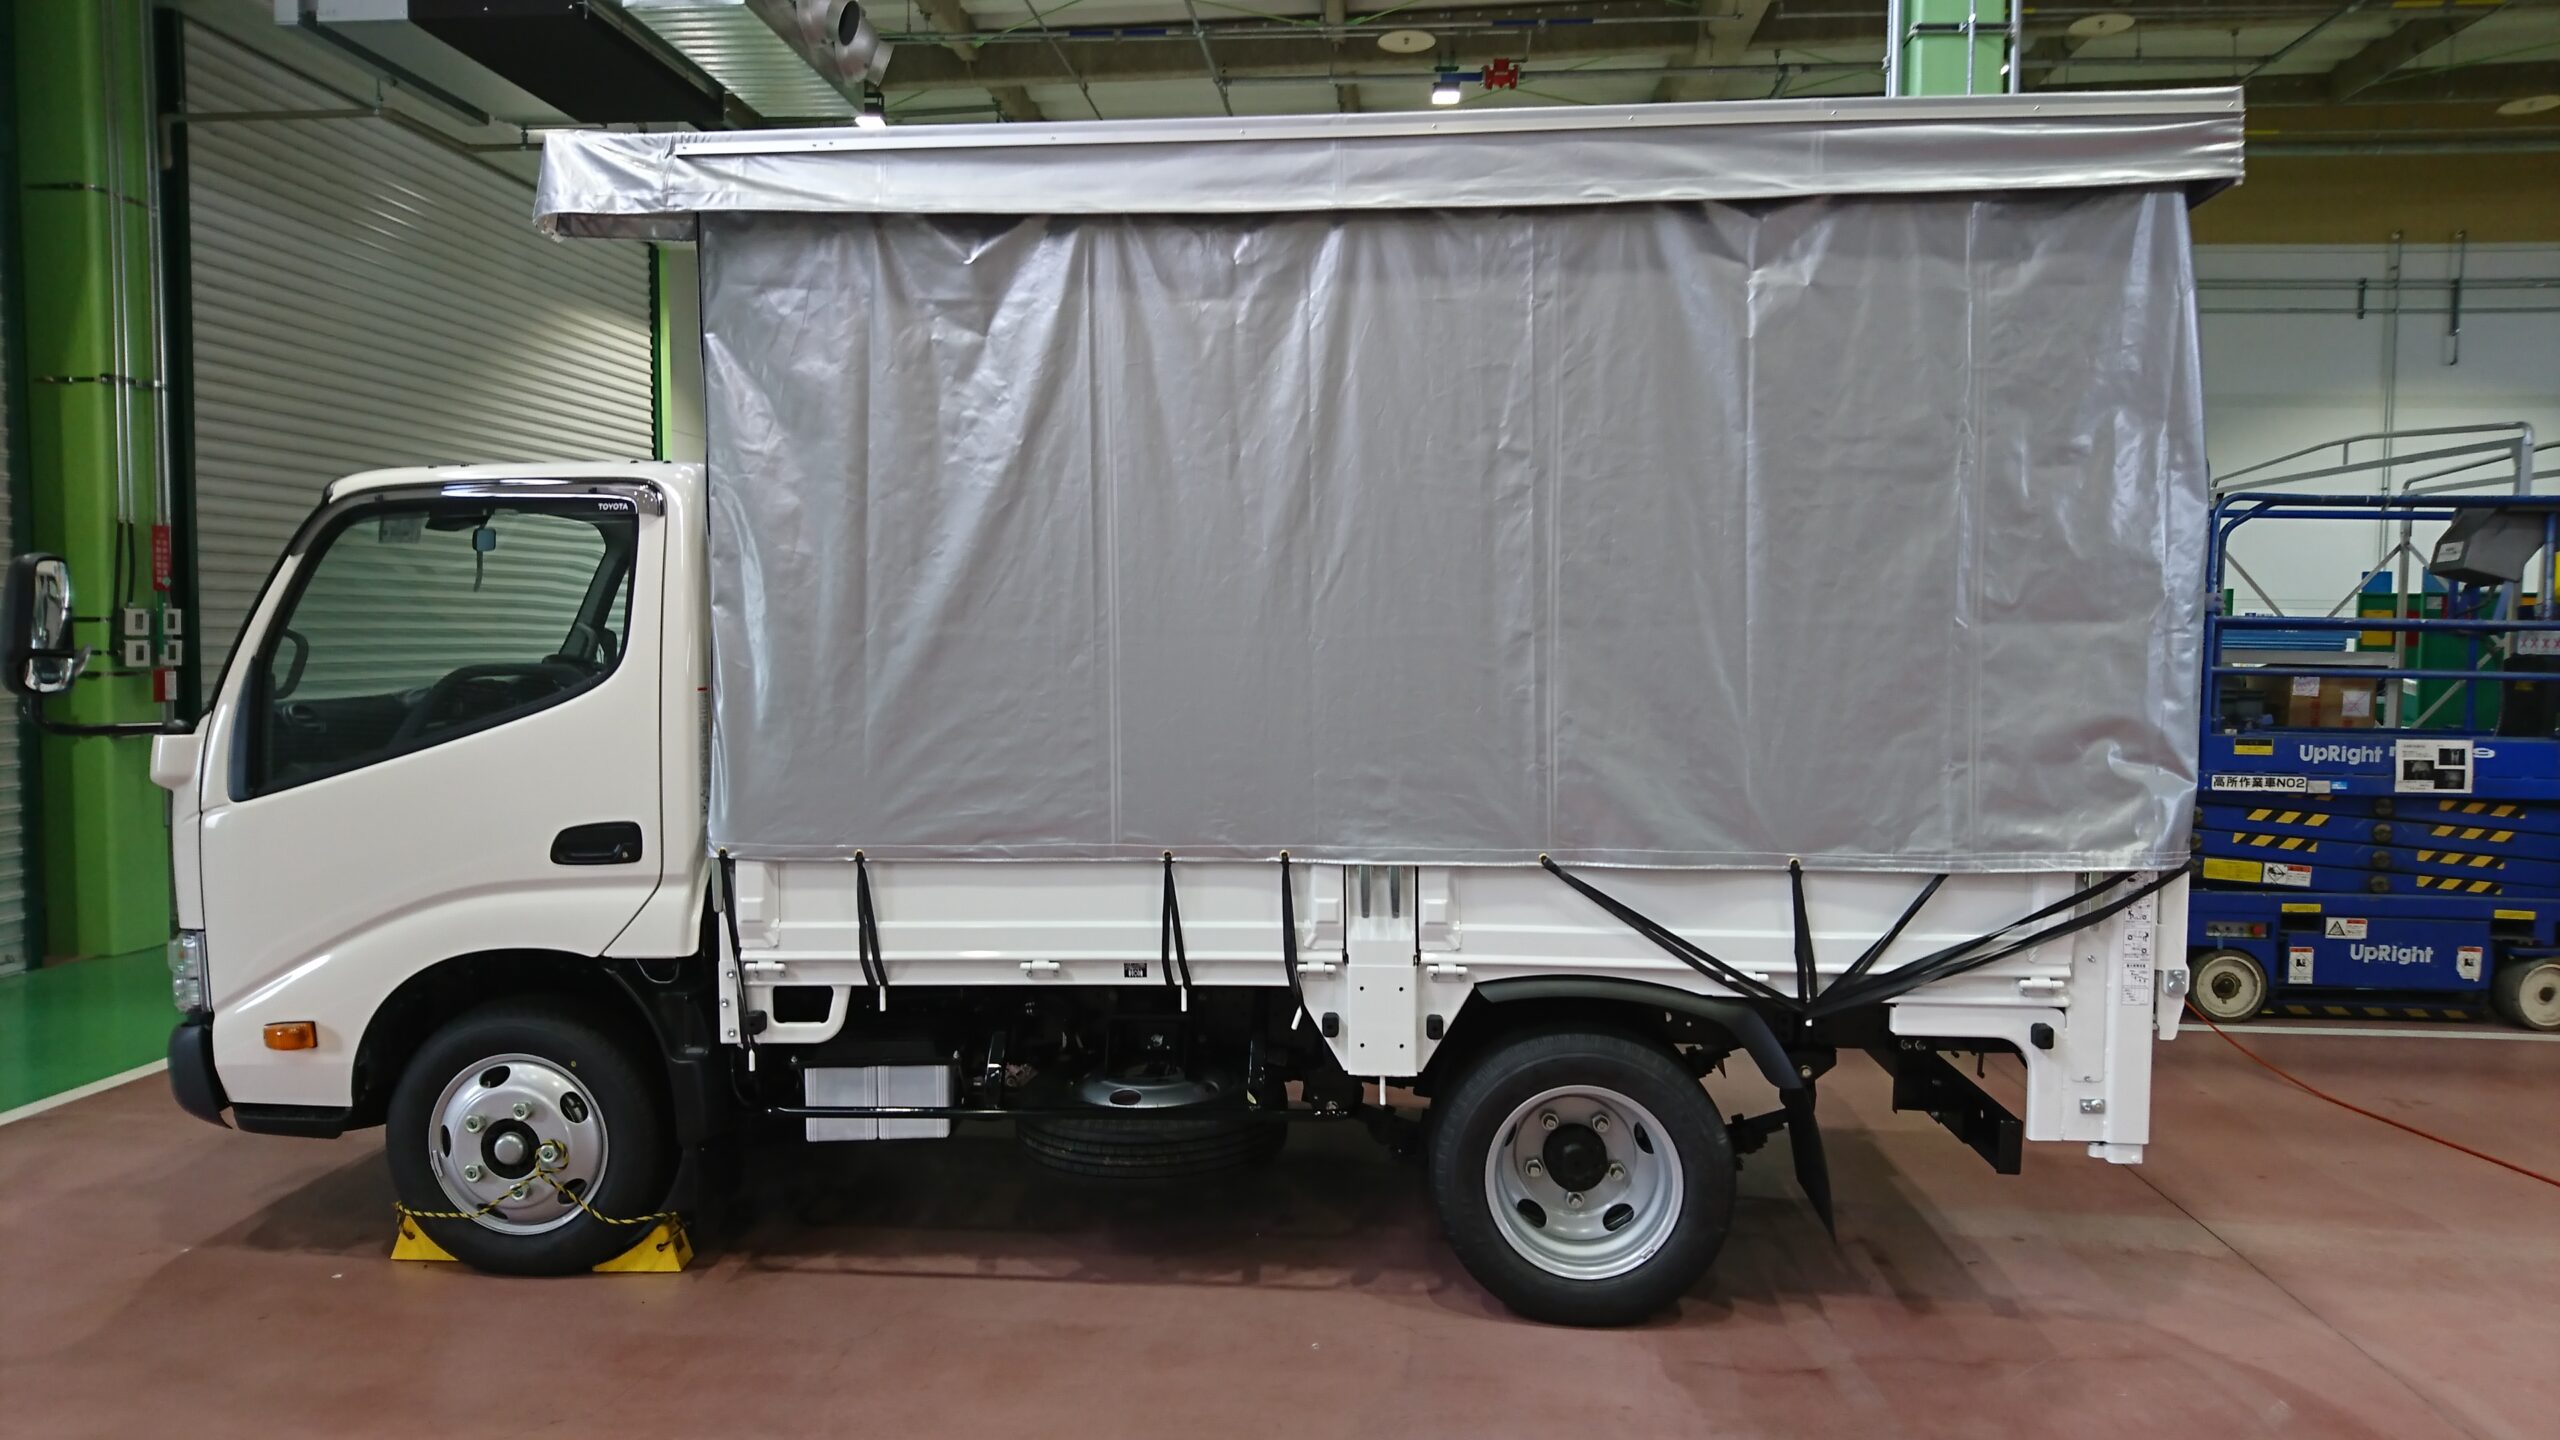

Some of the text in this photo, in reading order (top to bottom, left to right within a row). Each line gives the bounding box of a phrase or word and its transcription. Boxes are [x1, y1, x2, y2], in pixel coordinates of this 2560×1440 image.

[598, 502, 629, 511] TOYOTA
[2299, 744, 2383, 765] UpRight
[2350, 943, 2434, 965] UpRight
